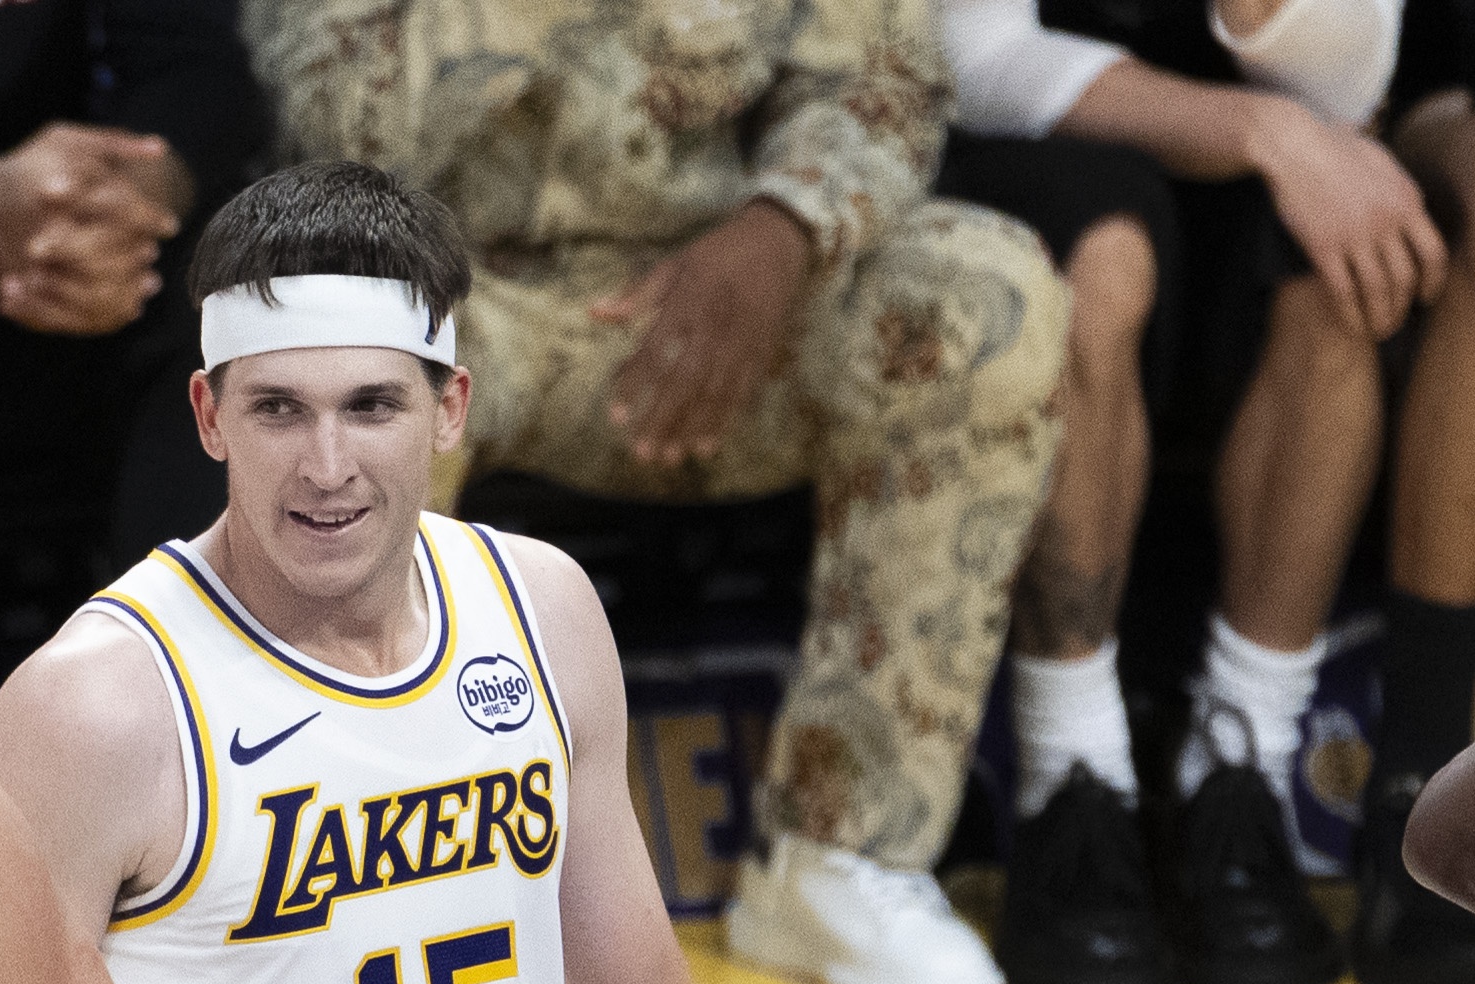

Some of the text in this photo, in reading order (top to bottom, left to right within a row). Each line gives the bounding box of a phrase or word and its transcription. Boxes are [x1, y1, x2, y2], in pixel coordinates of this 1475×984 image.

[462, 675, 528, 706] bibigo
[482, 701, 512, 717] 비비고
[225, 758, 561, 945] LAKERS
